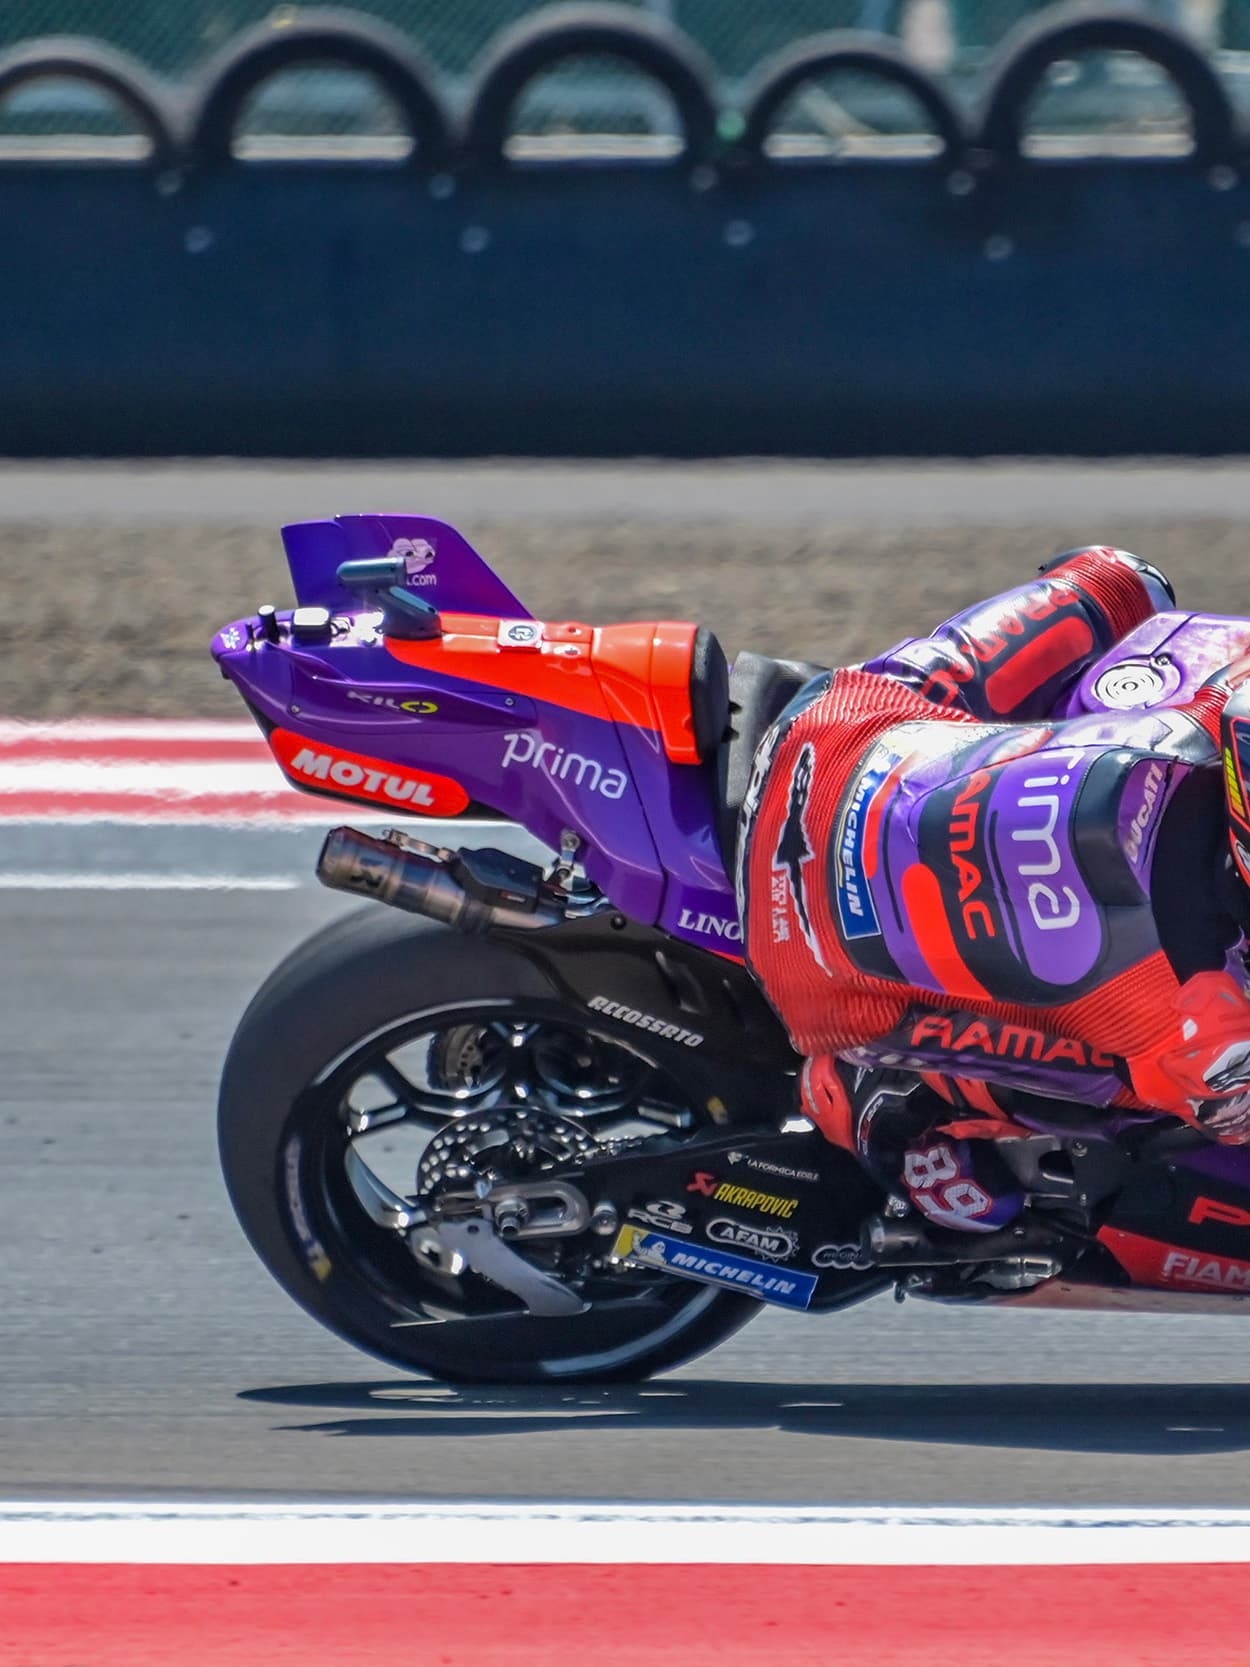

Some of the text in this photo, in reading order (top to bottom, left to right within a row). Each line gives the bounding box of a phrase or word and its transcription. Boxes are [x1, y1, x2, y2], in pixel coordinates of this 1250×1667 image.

[406, 573, 437, 586] .com
[290, 748, 435, 806] MOTUL
[502, 732, 628, 800] prima
[842, 776, 873, 917] MICHELIN
[1012, 750, 1086, 930] rima
[1124, 763, 1163, 864] DUCATI
[949, 770, 996, 940] AMAC
[906, 1145, 988, 1220] 89
[671, 1251, 797, 1295] MICHELIN
[720, 1226, 782, 1251] AFAM
